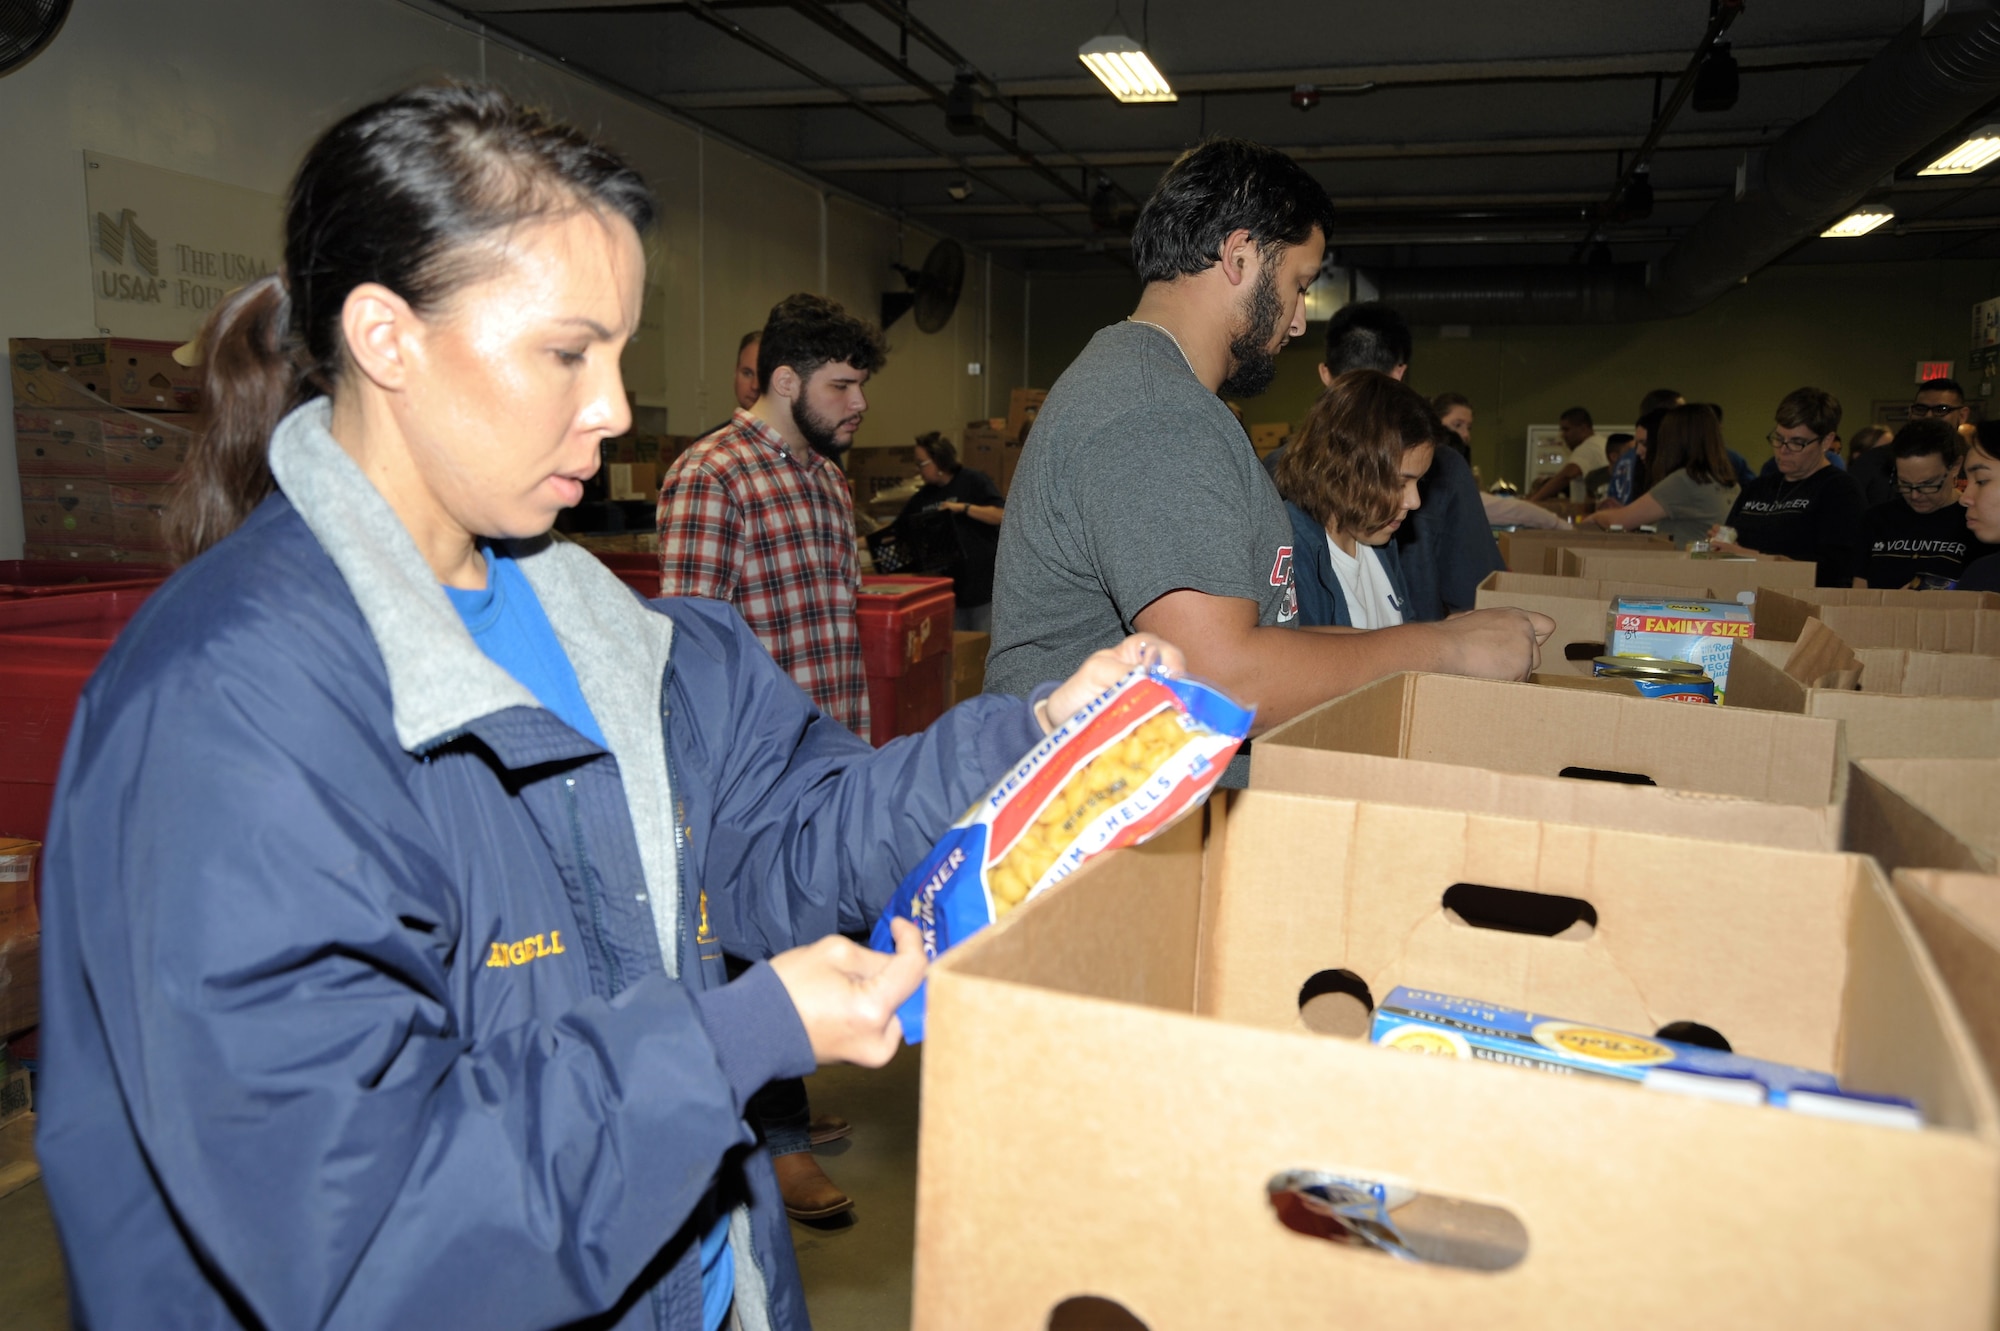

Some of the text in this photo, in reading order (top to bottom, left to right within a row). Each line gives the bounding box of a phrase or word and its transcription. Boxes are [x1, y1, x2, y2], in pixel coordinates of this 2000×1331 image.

[176, 243, 268, 281] THE USAA
[101, 270, 161, 303] USAA
[1921, 362, 1950, 381] EXIT
[1887, 539, 1967, 557] VOLUNTEER
[1645, 617, 1750, 638] FAMILY SIZE
[1701, 652, 1729, 663] FRUI
[991, 730, 1070, 808] MEDIUM
